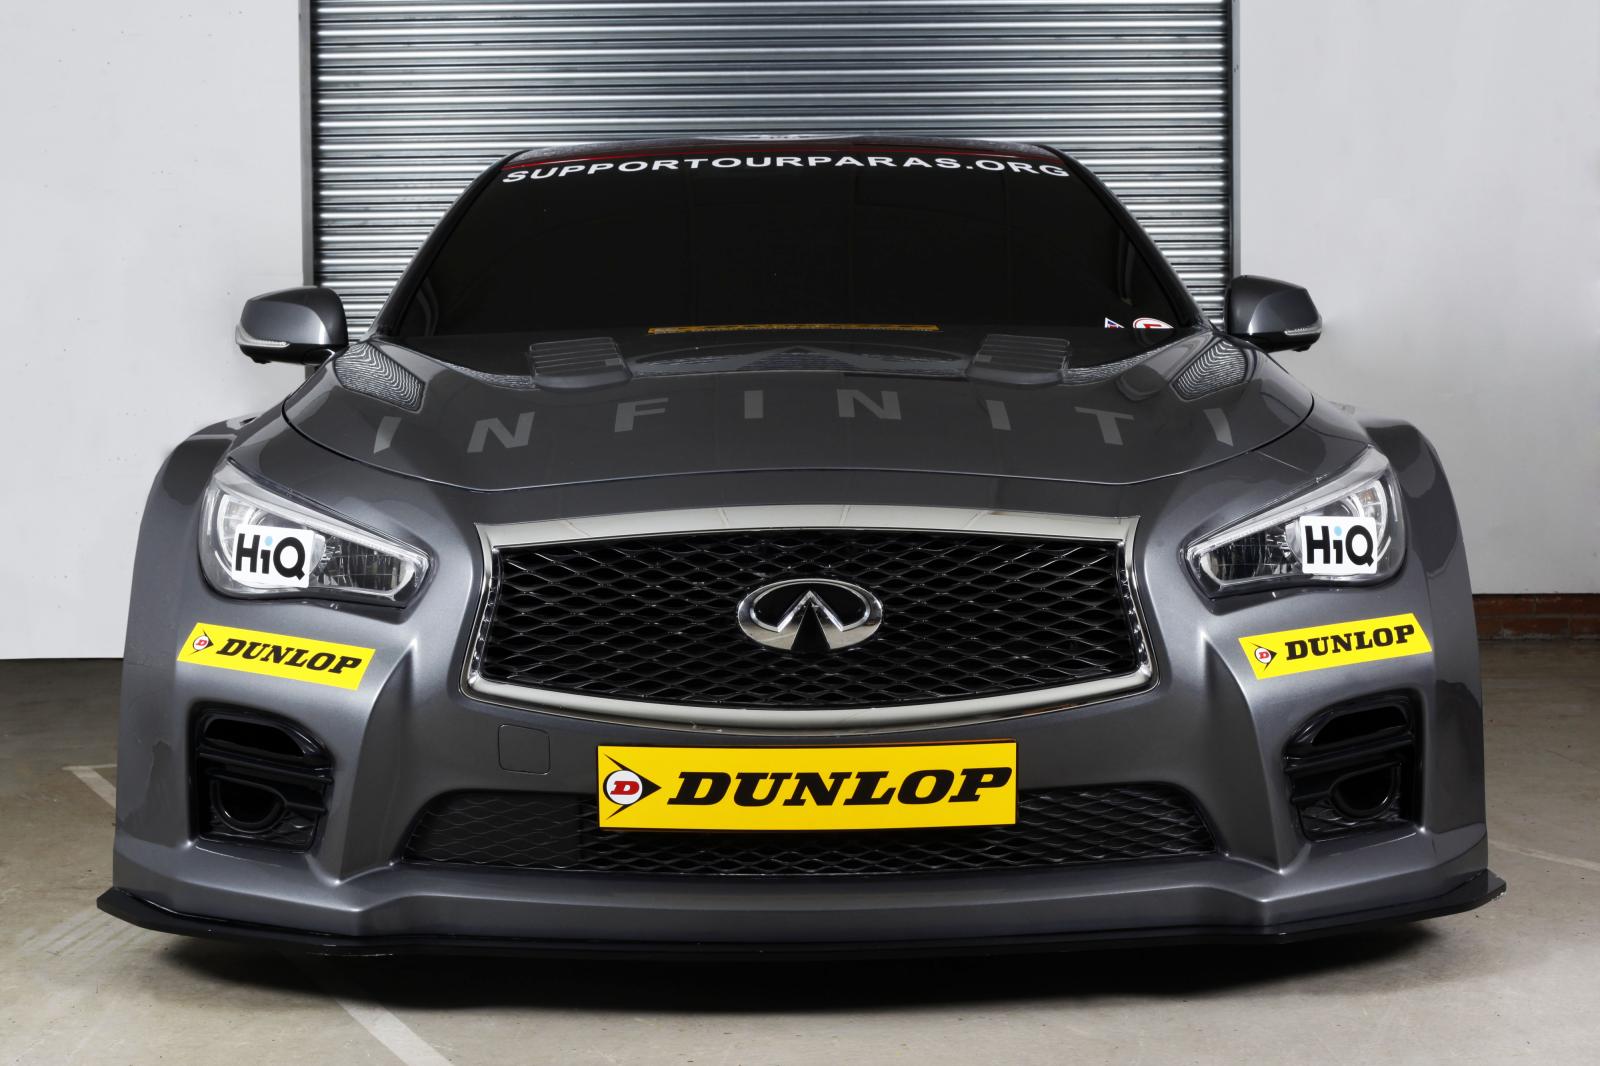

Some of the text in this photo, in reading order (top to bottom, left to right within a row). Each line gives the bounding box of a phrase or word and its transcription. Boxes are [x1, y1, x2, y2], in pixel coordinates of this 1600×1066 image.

[502, 156, 1070, 183] SUPPORTOURPARAS.ORG
[235, 533, 306, 581] HiQ
[1304, 525, 1374, 567] HiQ
[216, 638, 362, 674] DUNLOP
[1285, 624, 1415, 661] DUNLOP
[609, 767, 1013, 807] D DUNLOP
